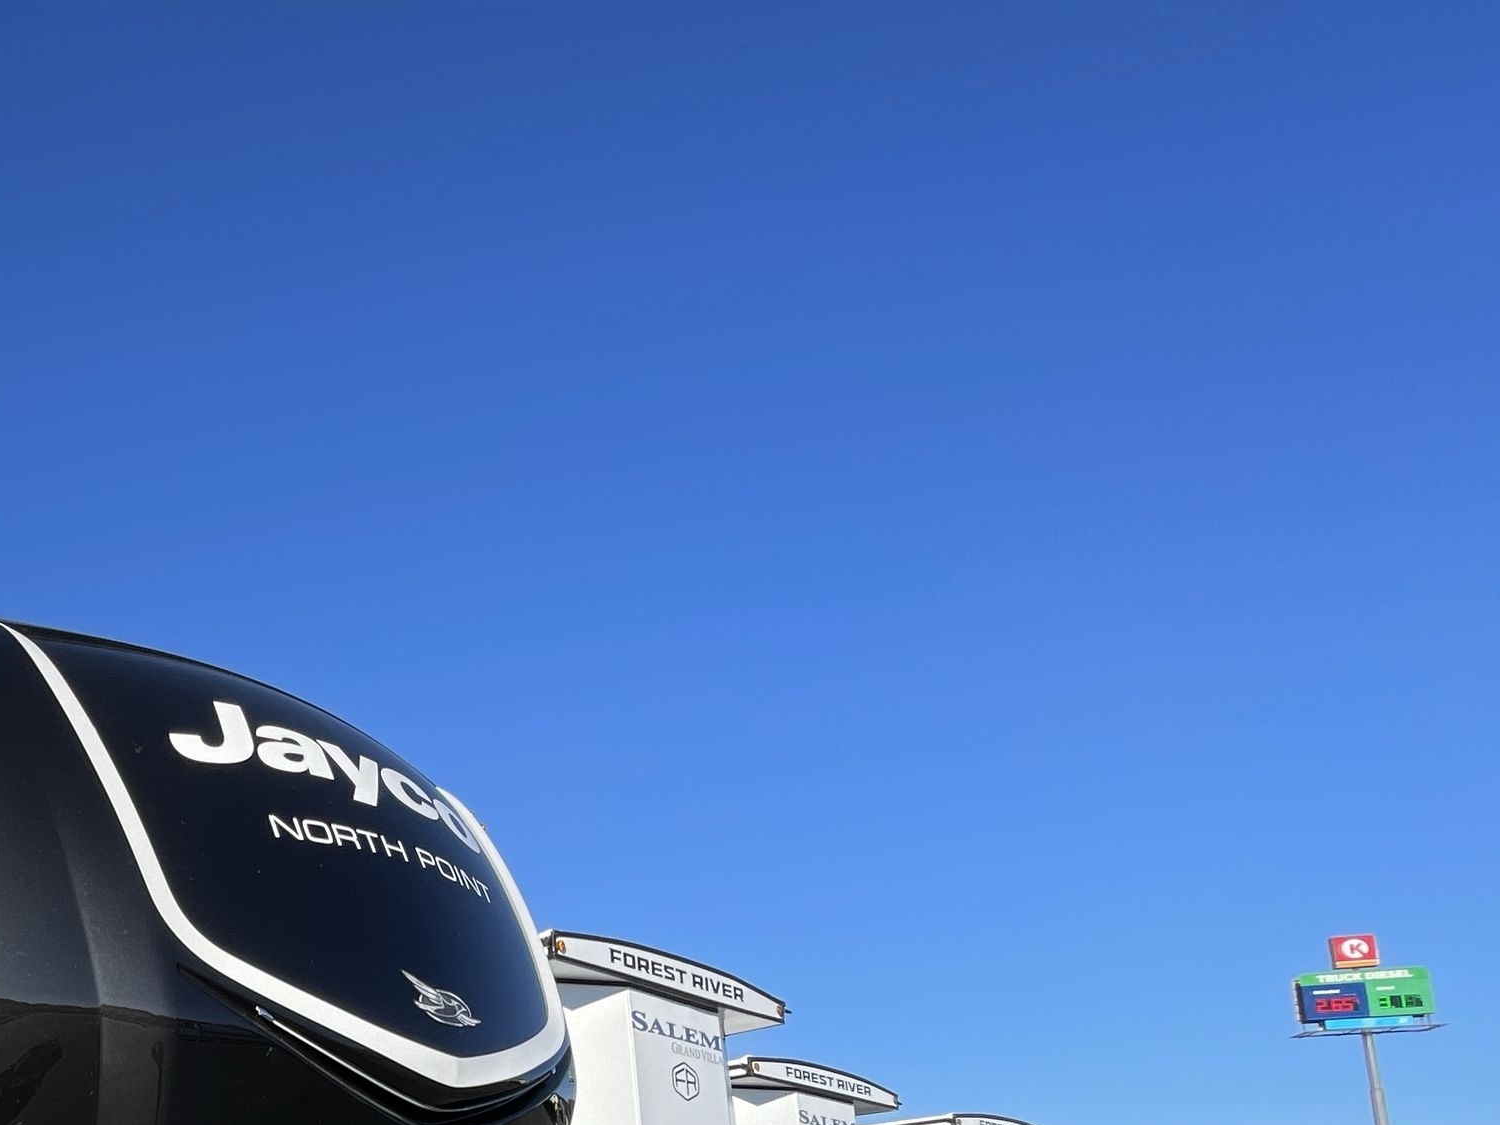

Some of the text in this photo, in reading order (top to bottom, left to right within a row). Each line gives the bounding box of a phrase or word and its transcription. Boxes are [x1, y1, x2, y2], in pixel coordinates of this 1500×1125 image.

[168, 701, 480, 853] Jayco
[268, 814, 491, 903] NORTH POINT
[609, 948, 745, 1002] FOREST RIVER
[631, 1010, 722, 1051] SALEM
[785, 1066, 872, 1096] FOREST RIVER
